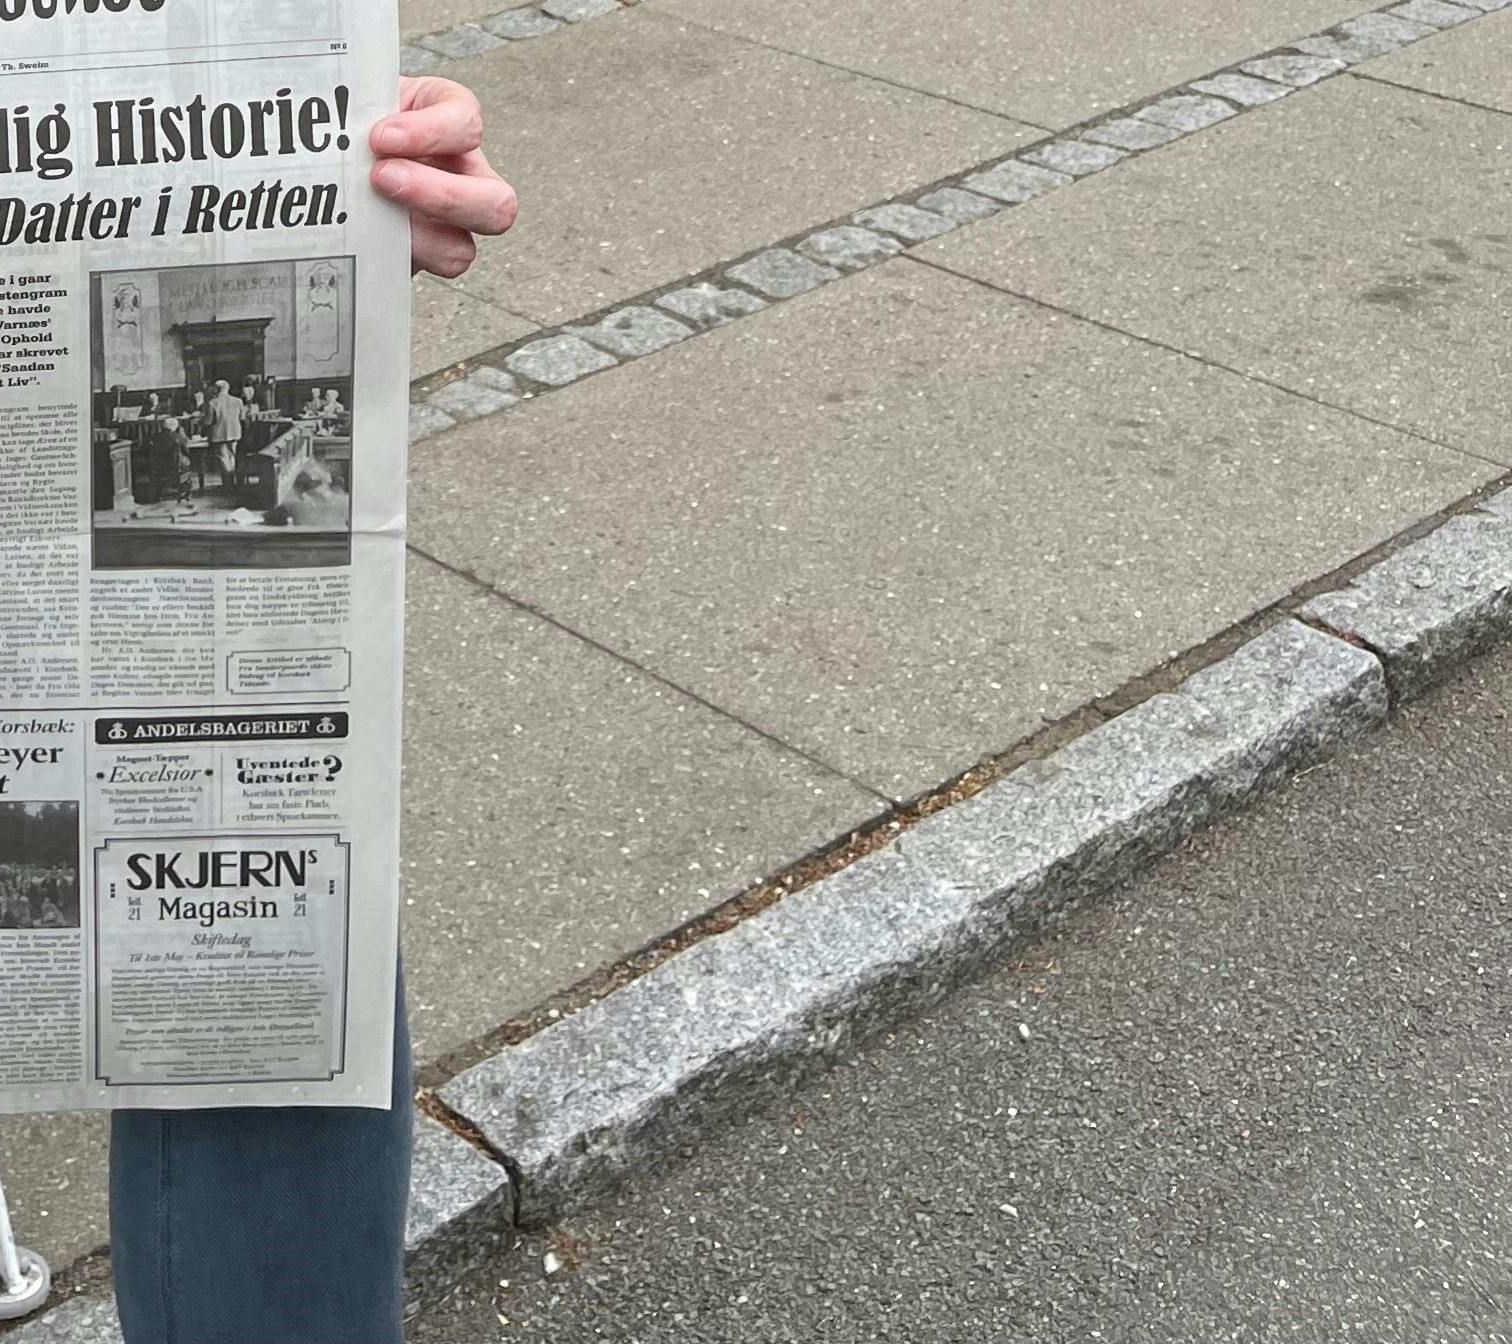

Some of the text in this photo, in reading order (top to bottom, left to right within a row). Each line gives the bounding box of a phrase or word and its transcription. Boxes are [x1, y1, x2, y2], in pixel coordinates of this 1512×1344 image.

[93, 85, 350, 167] Historie!
[151, 186, 172, 236] i
[182, 180, 347, 234] Retten.
[10, 275, 14, 284] i
[18, 275, 51, 286] gaar
[8, 304, 50, 314] havde
[1, 332, 52, 345] Ophold
[16, 347, 69, 357] skrevet
[133, 720, 311, 738] ANDELSBAGERIET
[236, 757, 320, 770] Uventede
[108, 764, 202, 784] Excelsior
[128, 907, 140, 920] 21
[158, 896, 278, 927] Magasin
[294, 904, 306, 917] 21
